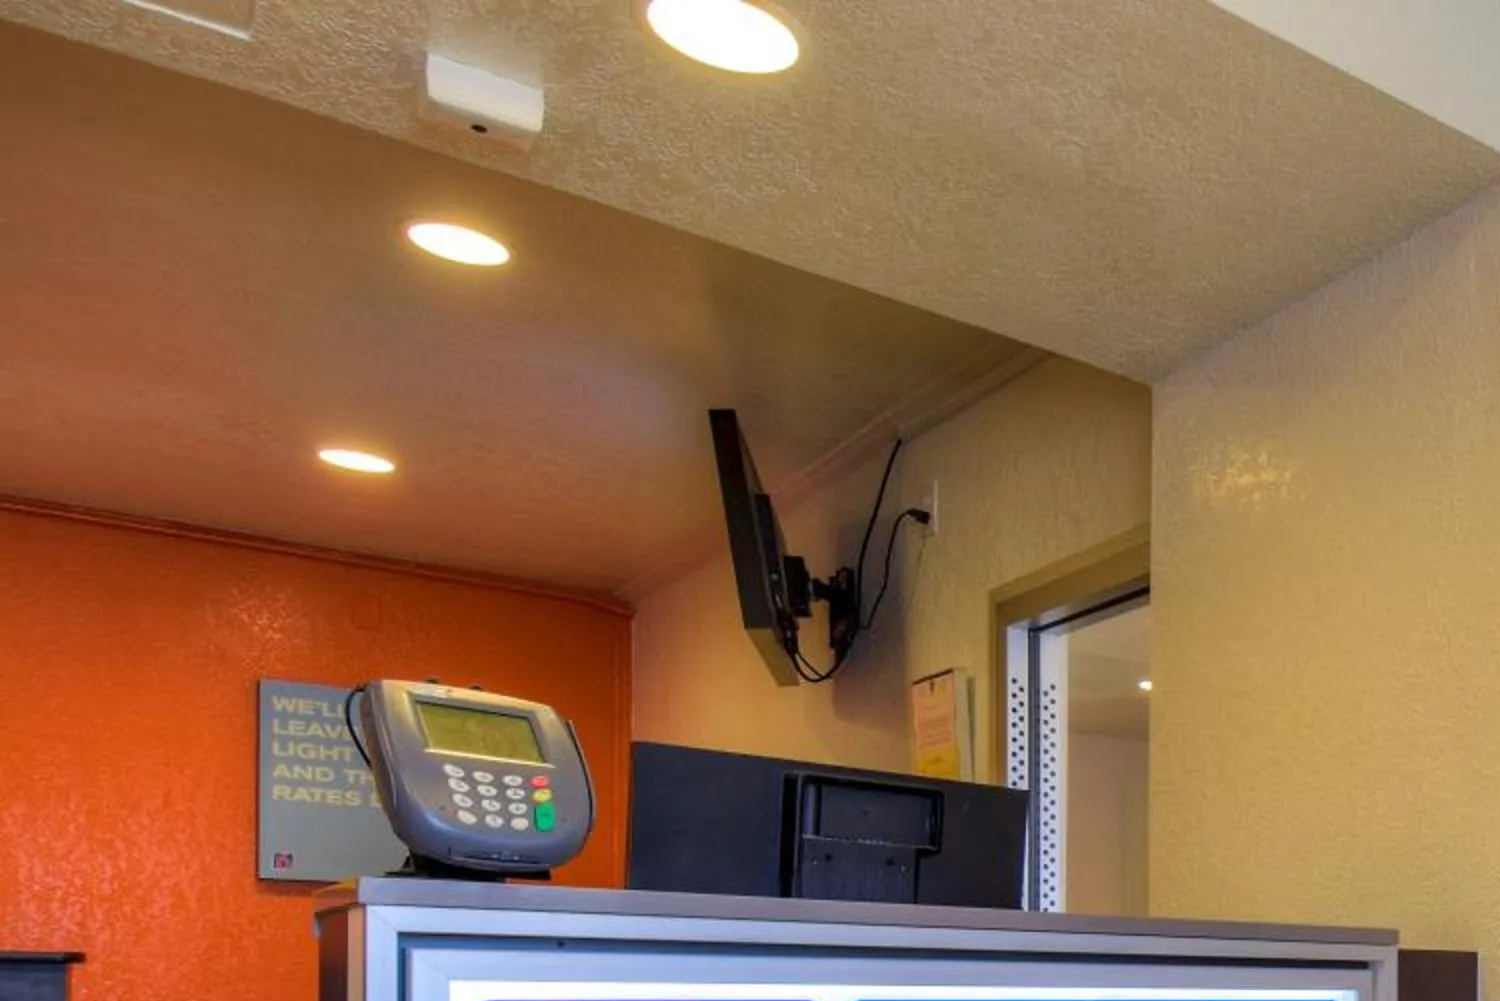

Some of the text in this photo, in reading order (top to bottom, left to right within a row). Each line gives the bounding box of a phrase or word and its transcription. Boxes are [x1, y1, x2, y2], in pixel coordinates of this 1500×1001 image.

[272, 719, 353, 740] LEAV
[272, 763, 375, 786] AND TH
[272, 785, 362, 806] RATES
